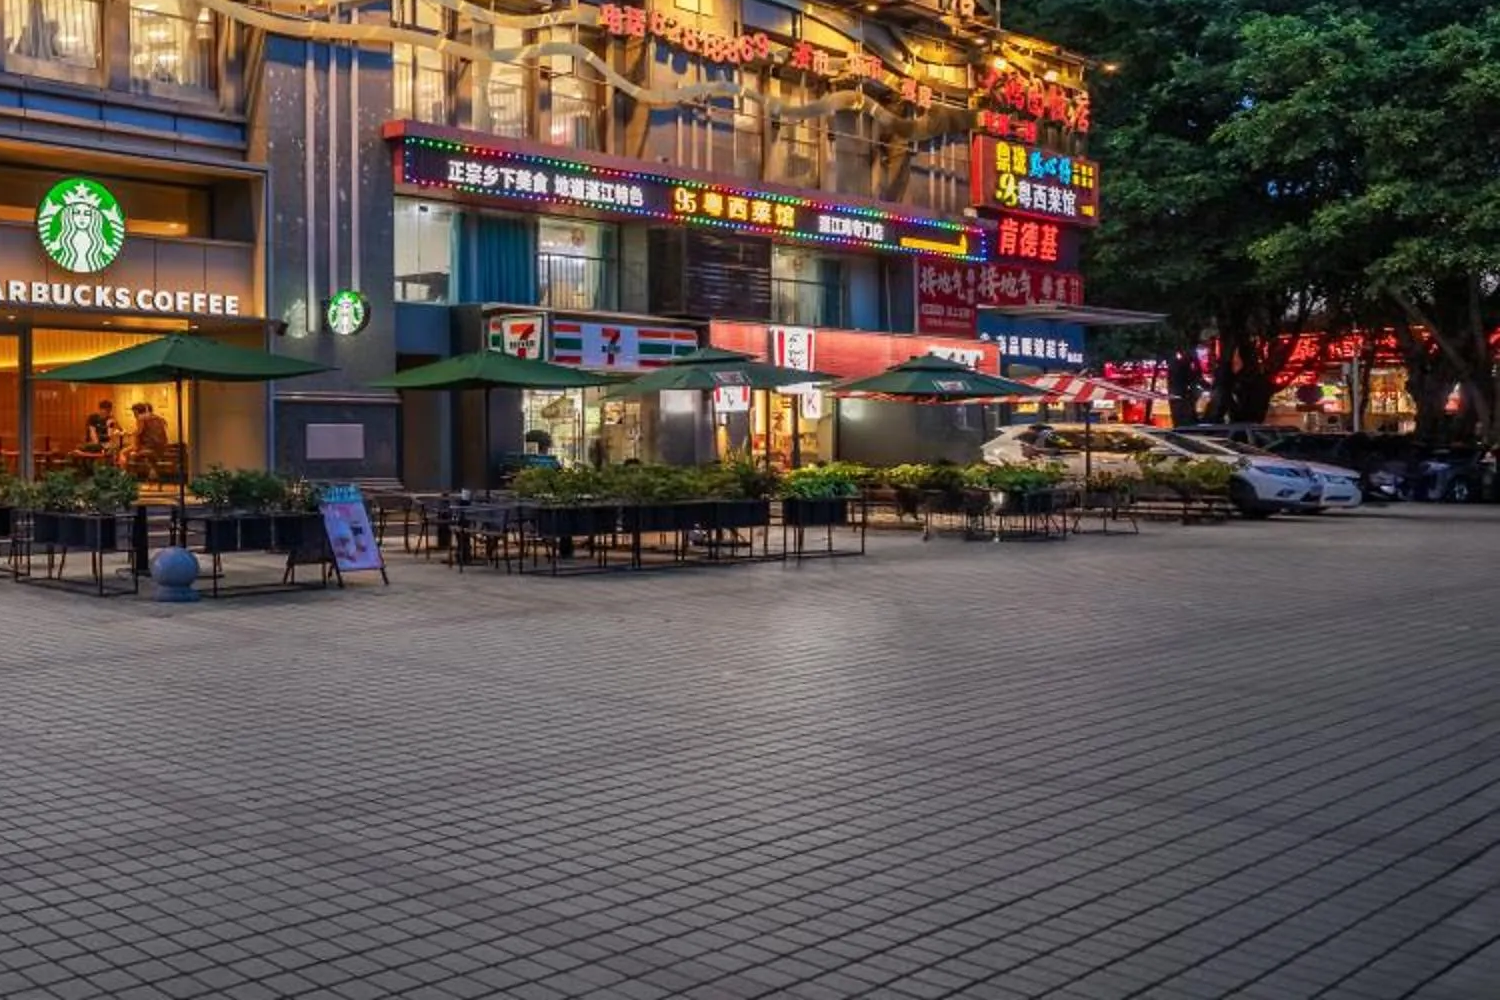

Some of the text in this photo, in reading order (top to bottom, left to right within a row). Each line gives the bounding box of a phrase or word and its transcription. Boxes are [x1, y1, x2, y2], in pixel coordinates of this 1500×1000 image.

[448, 160, 548, 193] 正宗乡下美食
[703, 191, 795, 229] 粤西菜馆
[1018, 180, 1077, 216] 粤西菜馆
[1000, 219, 1058, 261] 肯德基
[136, 288, 240, 316] COFFEE
